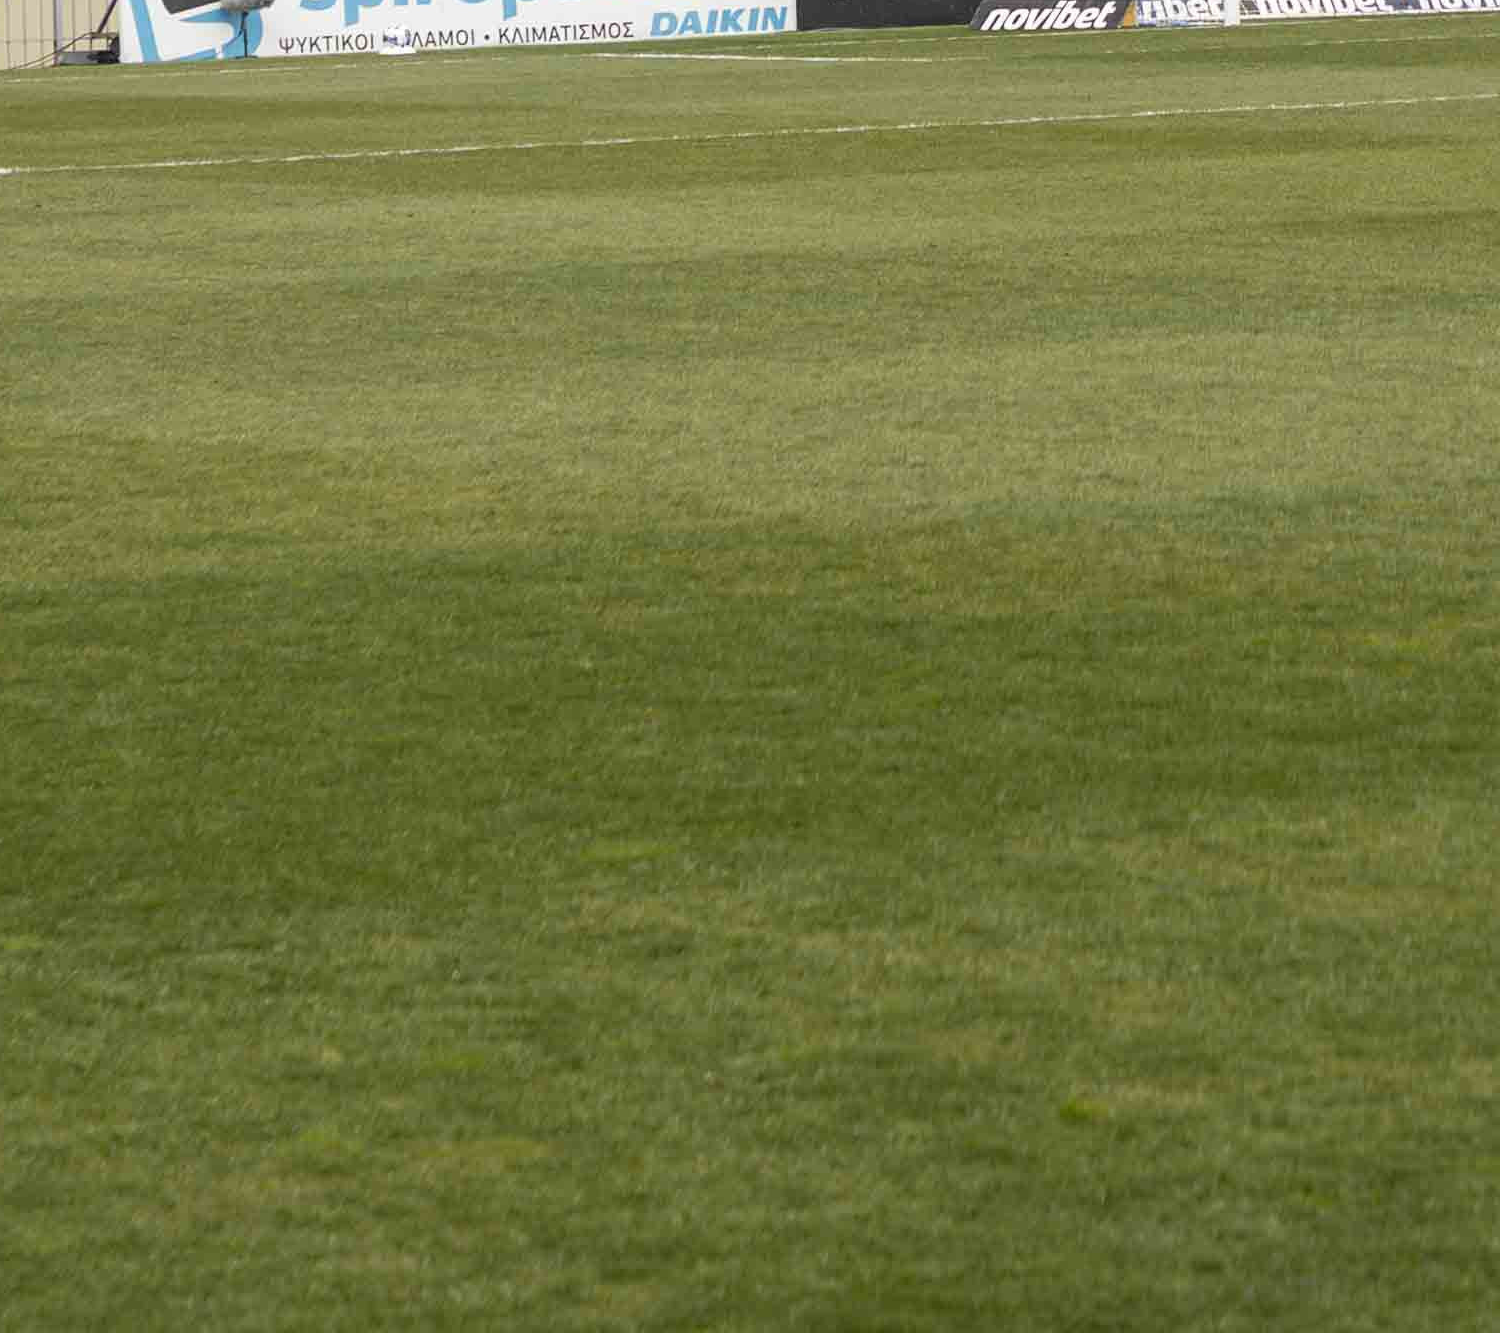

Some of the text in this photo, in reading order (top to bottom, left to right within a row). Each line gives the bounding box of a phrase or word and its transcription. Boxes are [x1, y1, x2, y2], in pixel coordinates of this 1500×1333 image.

[649, 6, 788, 37] DAIKIN
[983, 0, 1117, 31] novibet
[278, 21, 635, 55] ΨΥΚΤΙΚΟΙ ΛΑΜΟΙ ΚΛΙΜΑΤΙΣΜΟΣ
